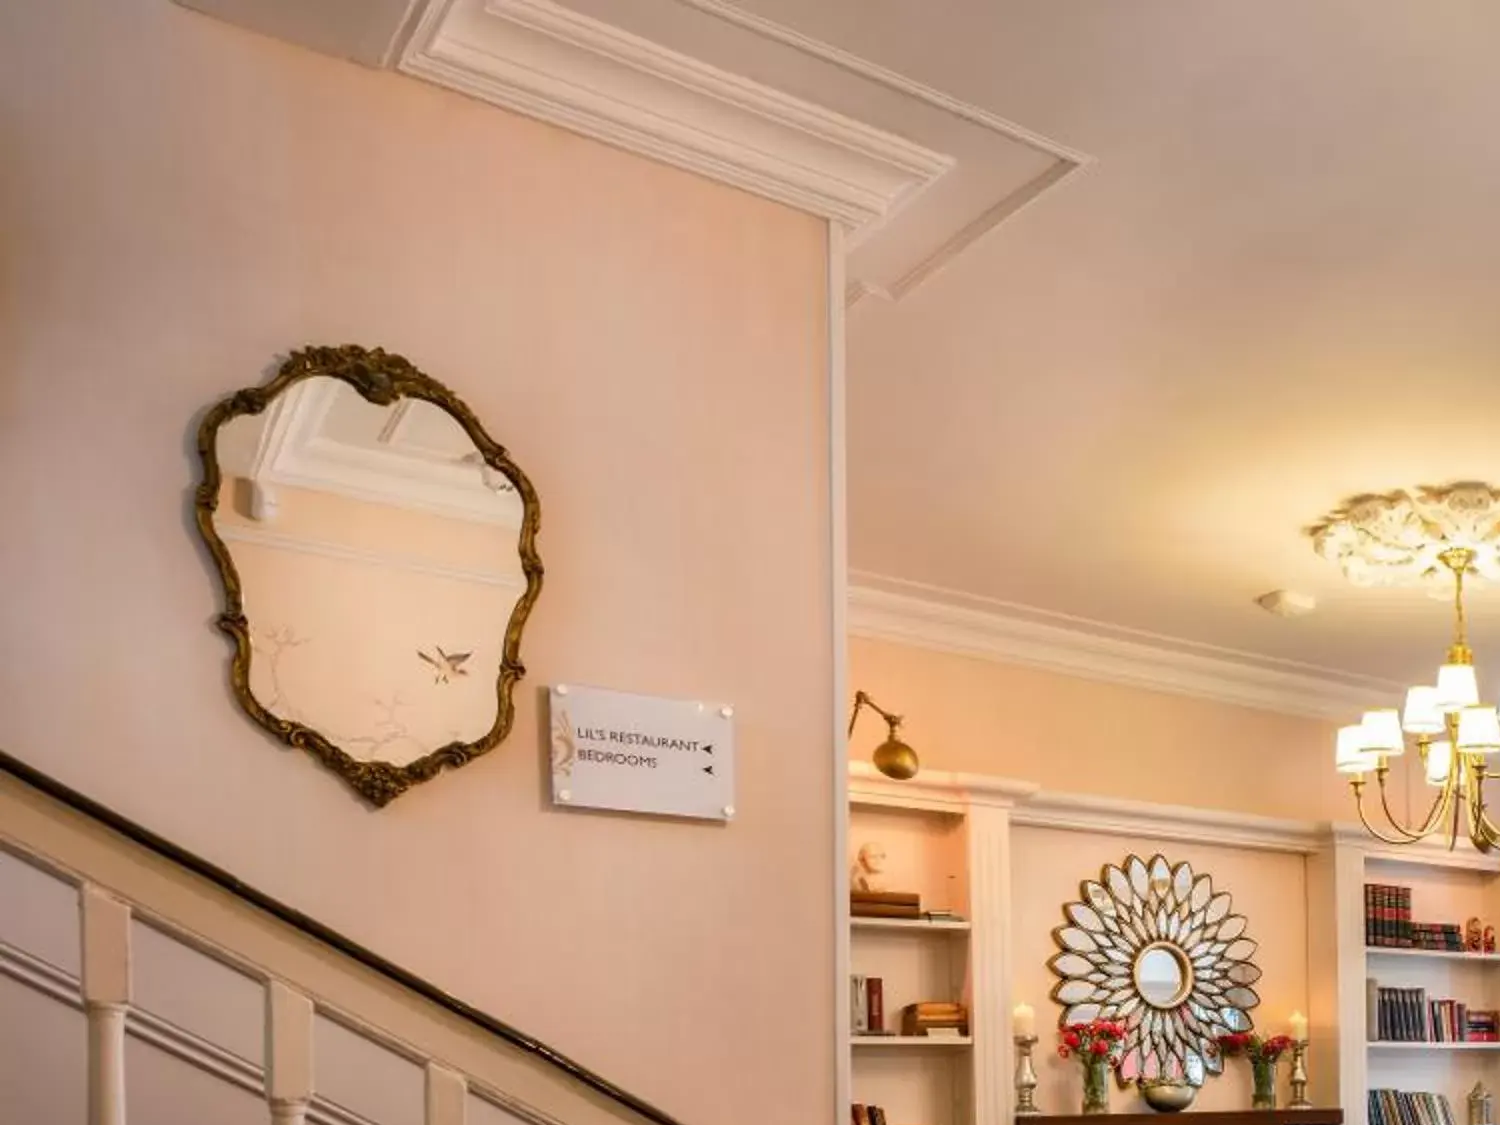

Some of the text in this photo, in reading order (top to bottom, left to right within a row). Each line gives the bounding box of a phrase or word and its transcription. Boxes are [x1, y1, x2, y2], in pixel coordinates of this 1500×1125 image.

[577, 727, 699, 753] LIL'S RESTAURANT
[577, 749, 658, 769] BEDROOMS
